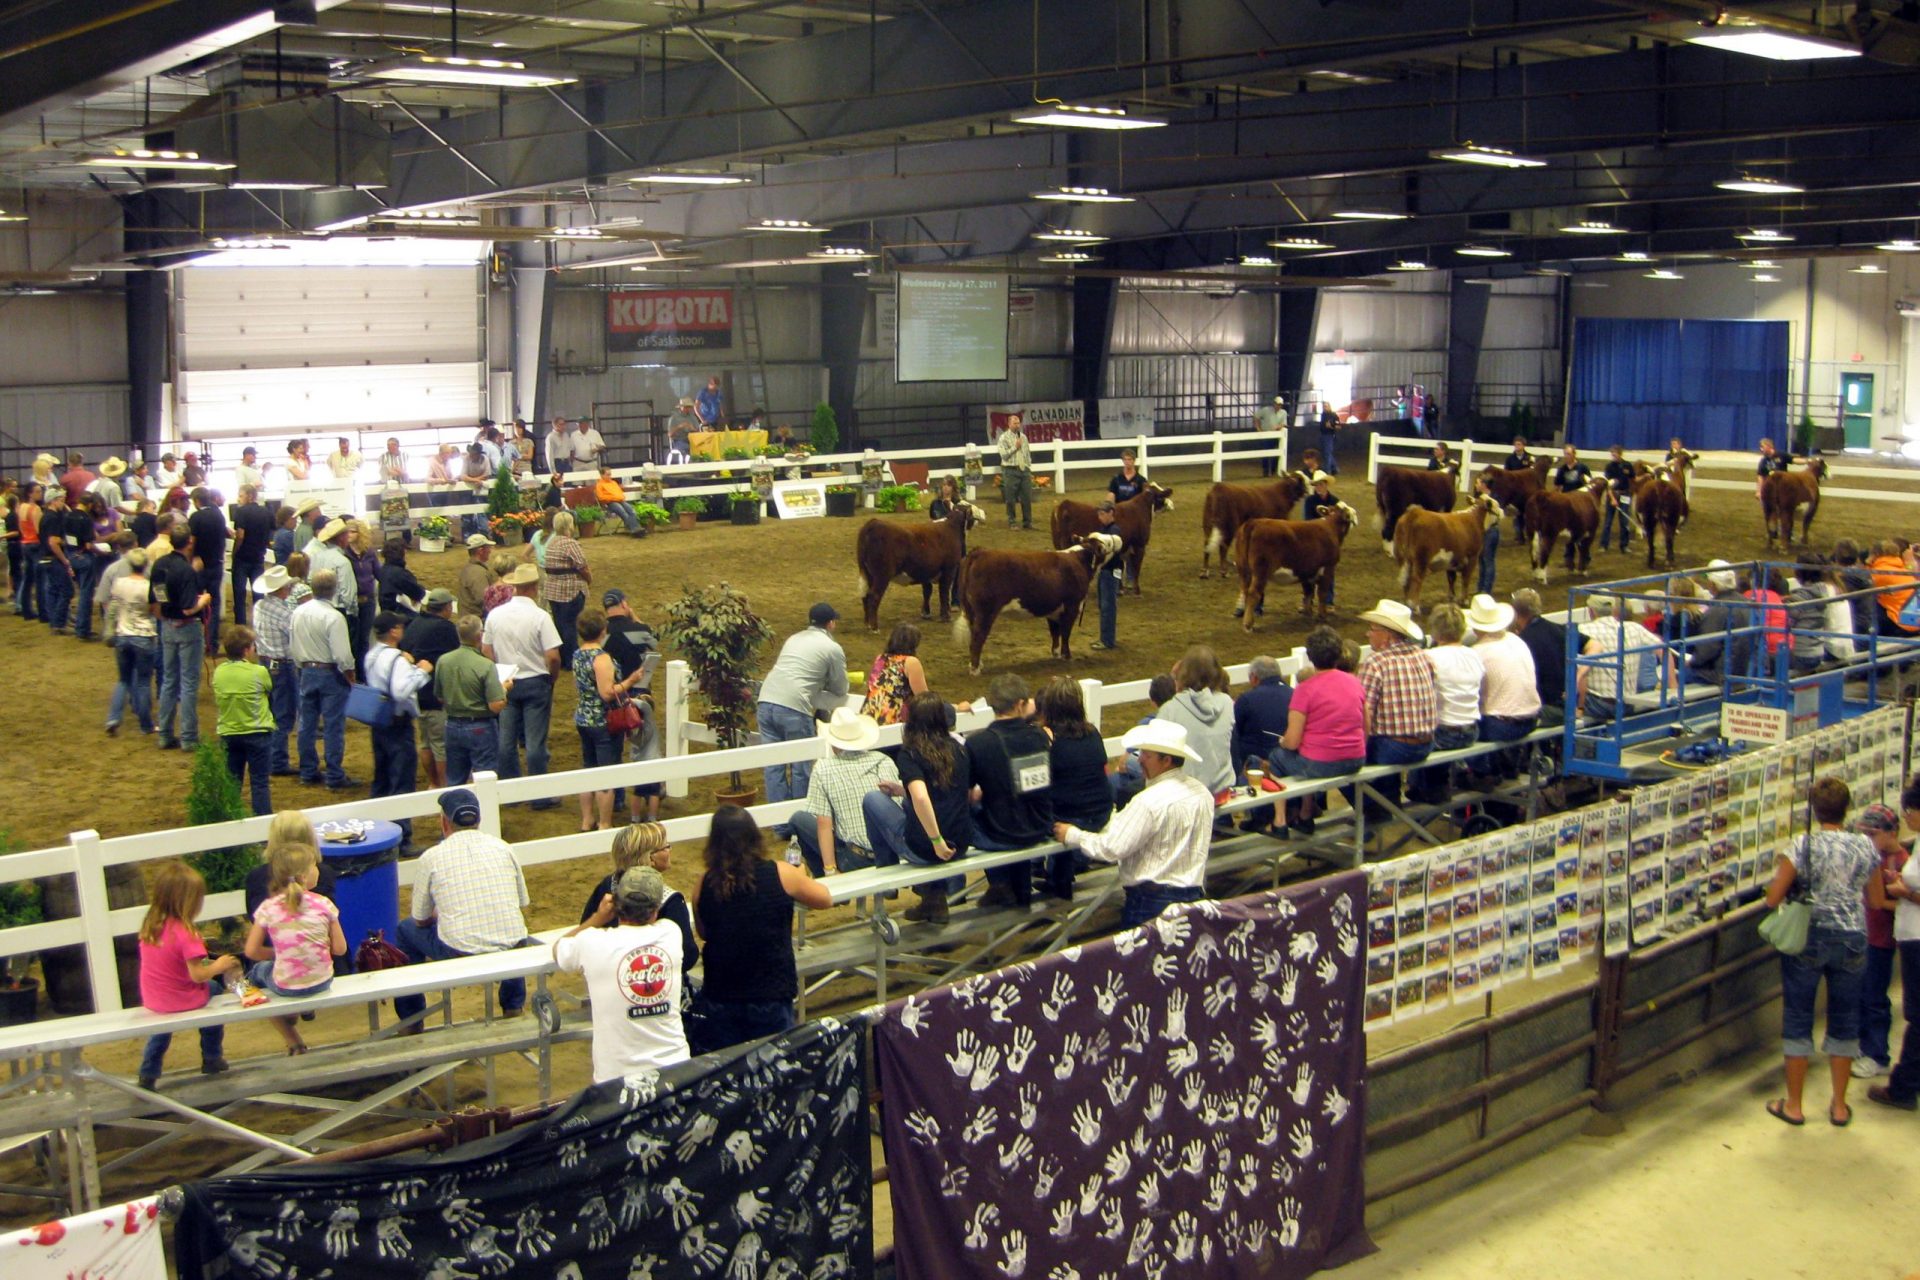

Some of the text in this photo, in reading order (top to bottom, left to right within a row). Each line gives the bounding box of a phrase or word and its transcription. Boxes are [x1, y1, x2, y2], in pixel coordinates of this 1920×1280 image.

[947, 279, 963, 289] July
[979, 280, 997, 289] 2011
[612, 297, 728, 326] KUBOTA
[637, 335, 704, 347] of Saskatoon
[1030, 407, 1081, 421] CANADIAN
[1586, 810, 1605, 821] 2002
[1609, 806, 1626, 817] 2001
[1537, 823, 1556, 836] 2004
[632, 1004, 668, 1016] EST. 1911
